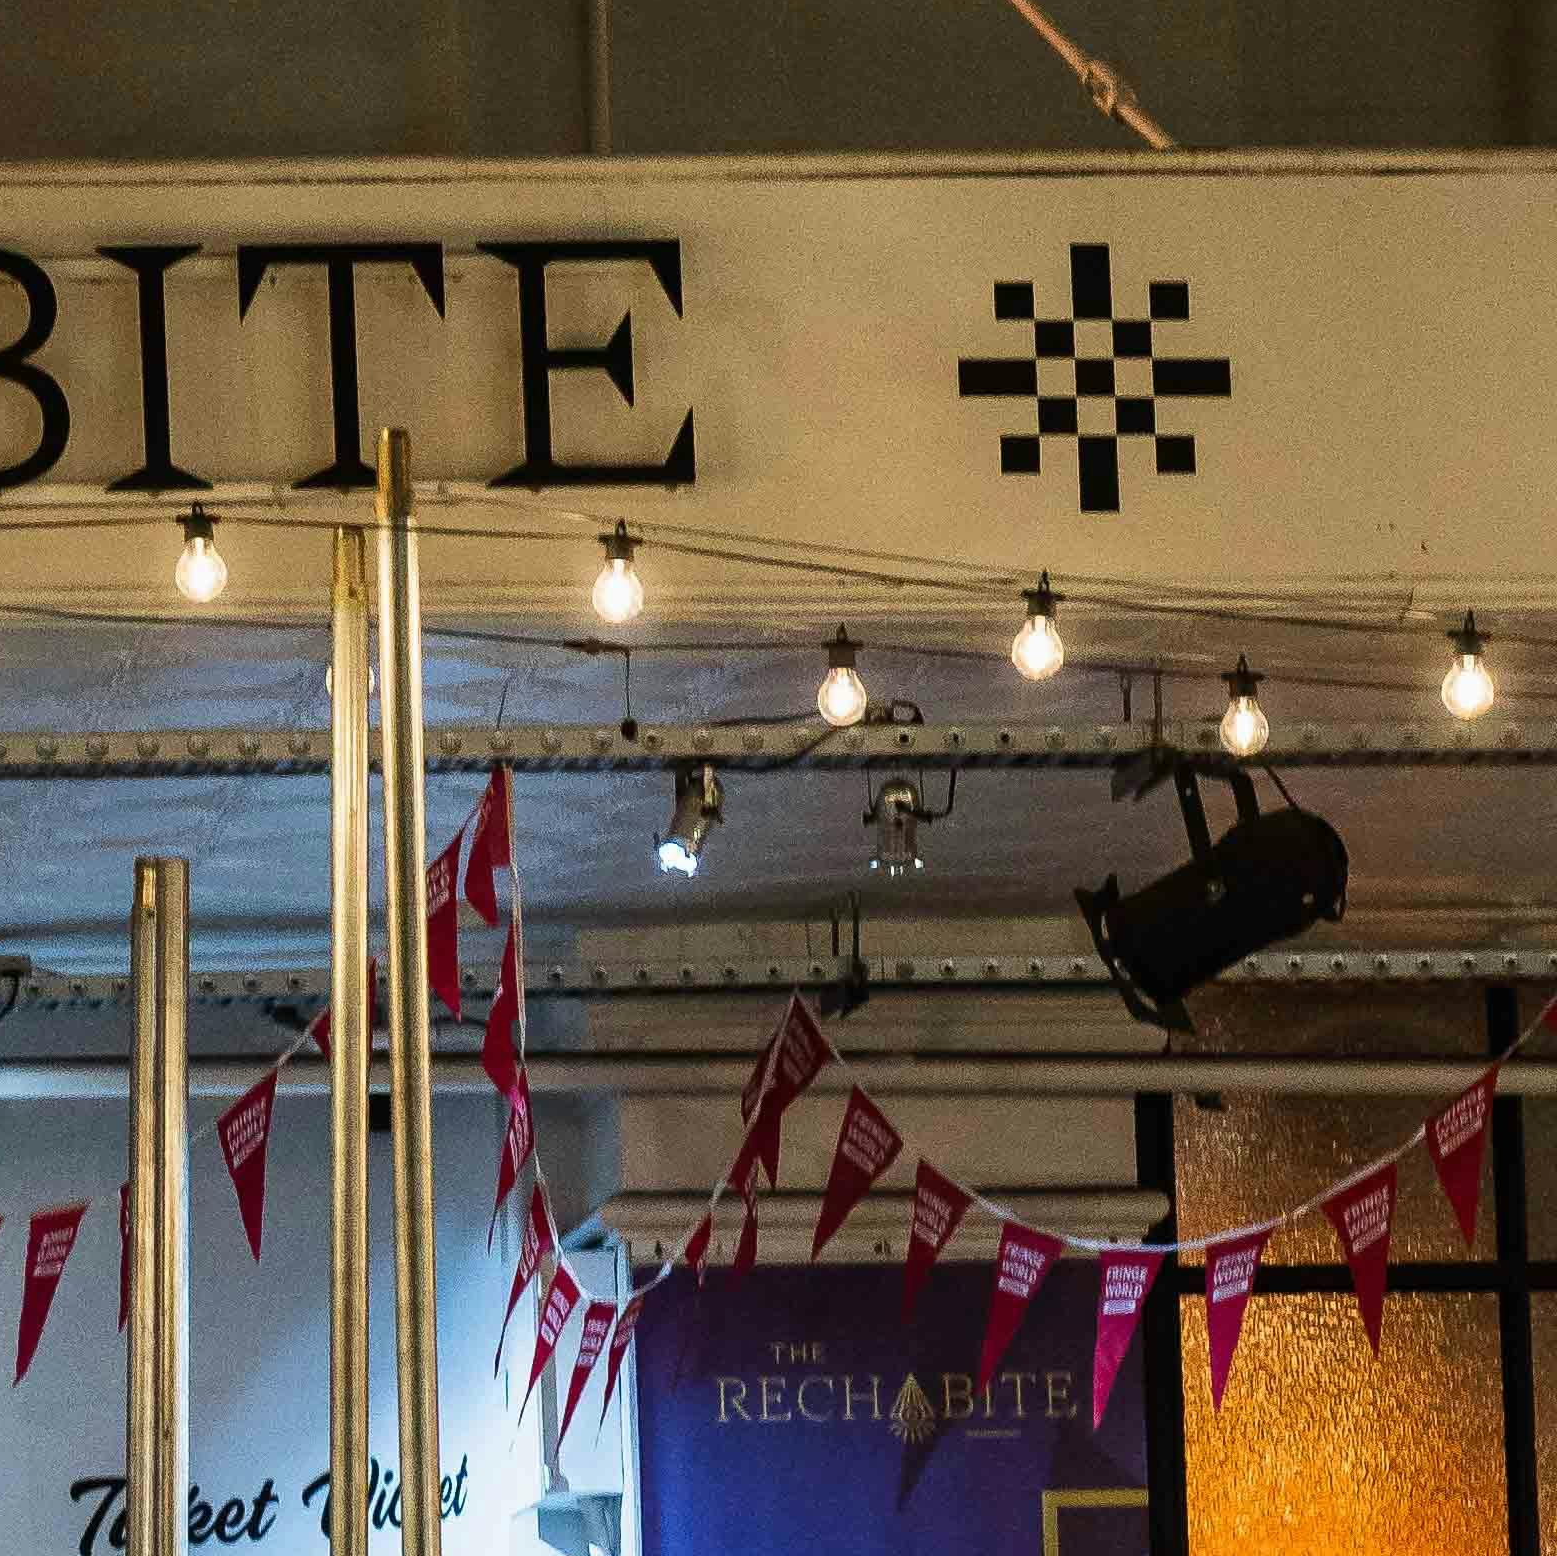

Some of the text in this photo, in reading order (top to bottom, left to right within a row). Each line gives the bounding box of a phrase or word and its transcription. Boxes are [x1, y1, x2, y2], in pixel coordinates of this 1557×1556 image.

[1106, 1265, 1148, 1284] FRINGE
[1105, 1282, 1143, 1301] WORLD
[771, 1342, 825, 1365] THE
[714, 1372, 1079, 1424] RECHABITE
[302, 1453, 469, 1542] Wicet
